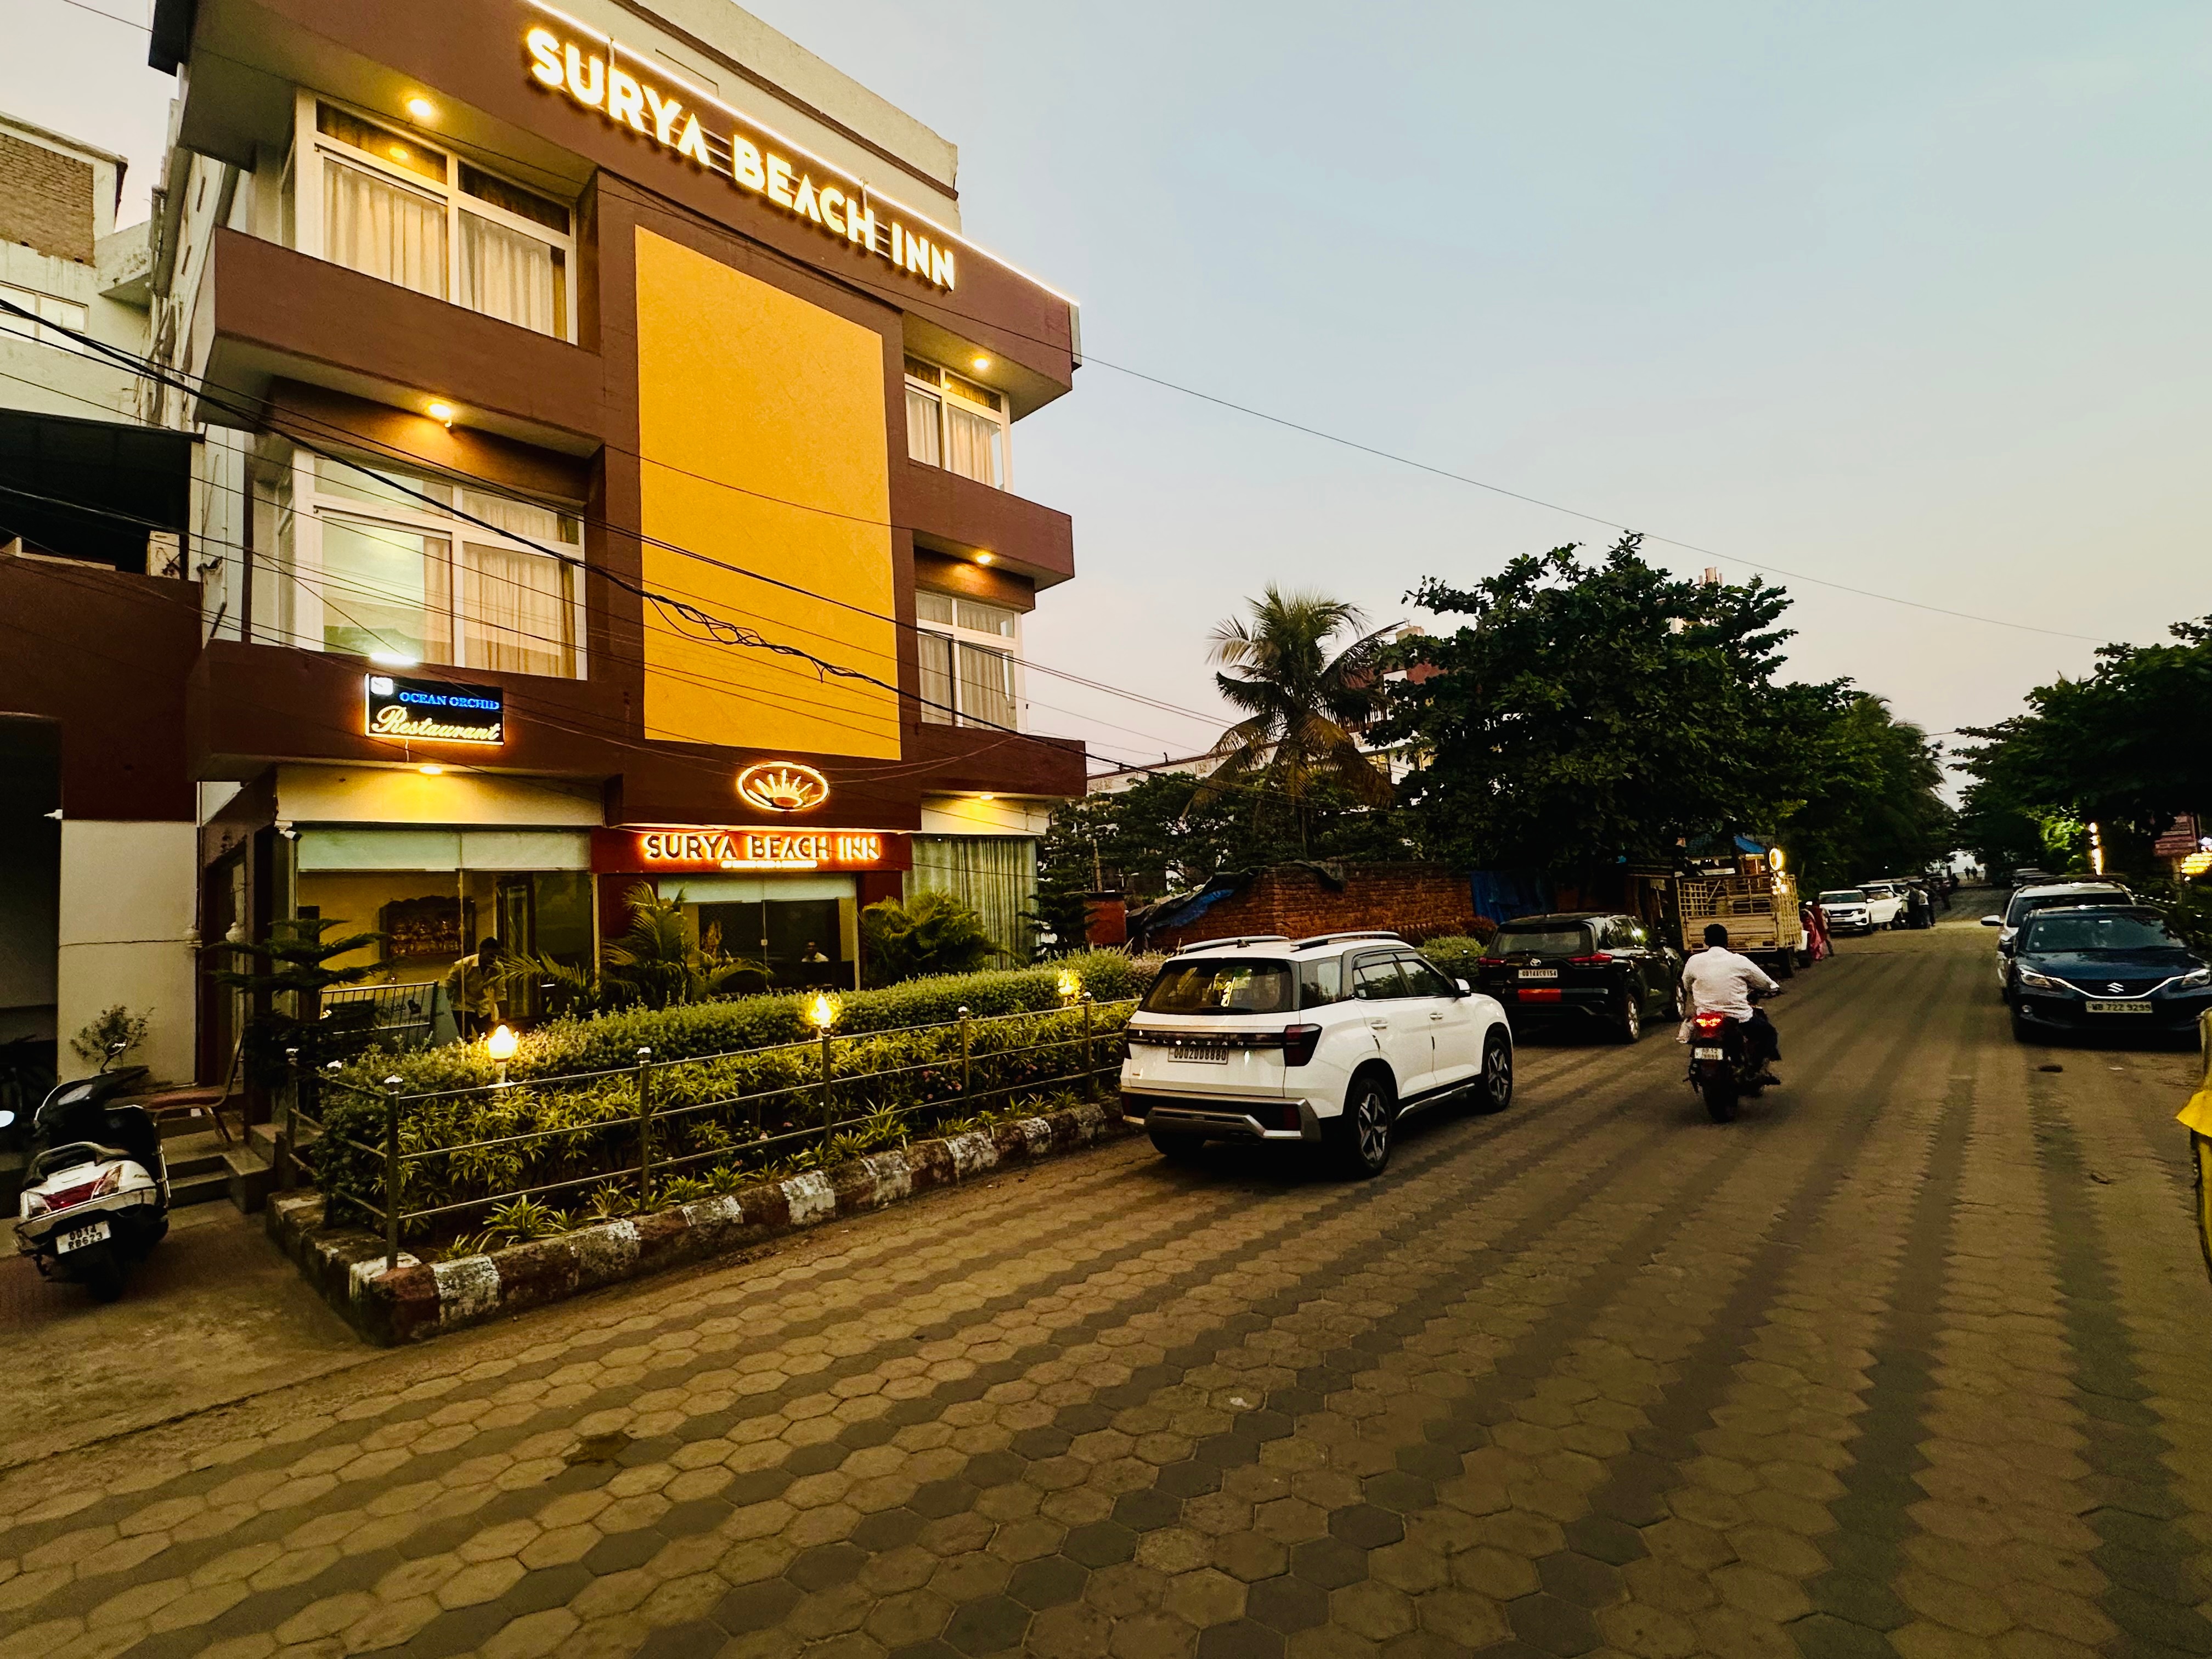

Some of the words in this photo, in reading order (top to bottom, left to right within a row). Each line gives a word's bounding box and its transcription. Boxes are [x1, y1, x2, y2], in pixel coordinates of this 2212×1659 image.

[527, 27, 711, 167] SURYA
[733, 134, 876, 252] BEACH
[890, 222, 955, 291] INN
[399, 692, 447, 705] OCEAN
[449, 697, 500, 710] ORCHID
[372, 706, 500, 740] Restaurant
[642, 834, 737, 860] SURYA
[747, 835, 831, 860] BEACH
[839, 837, 879, 860] INN
